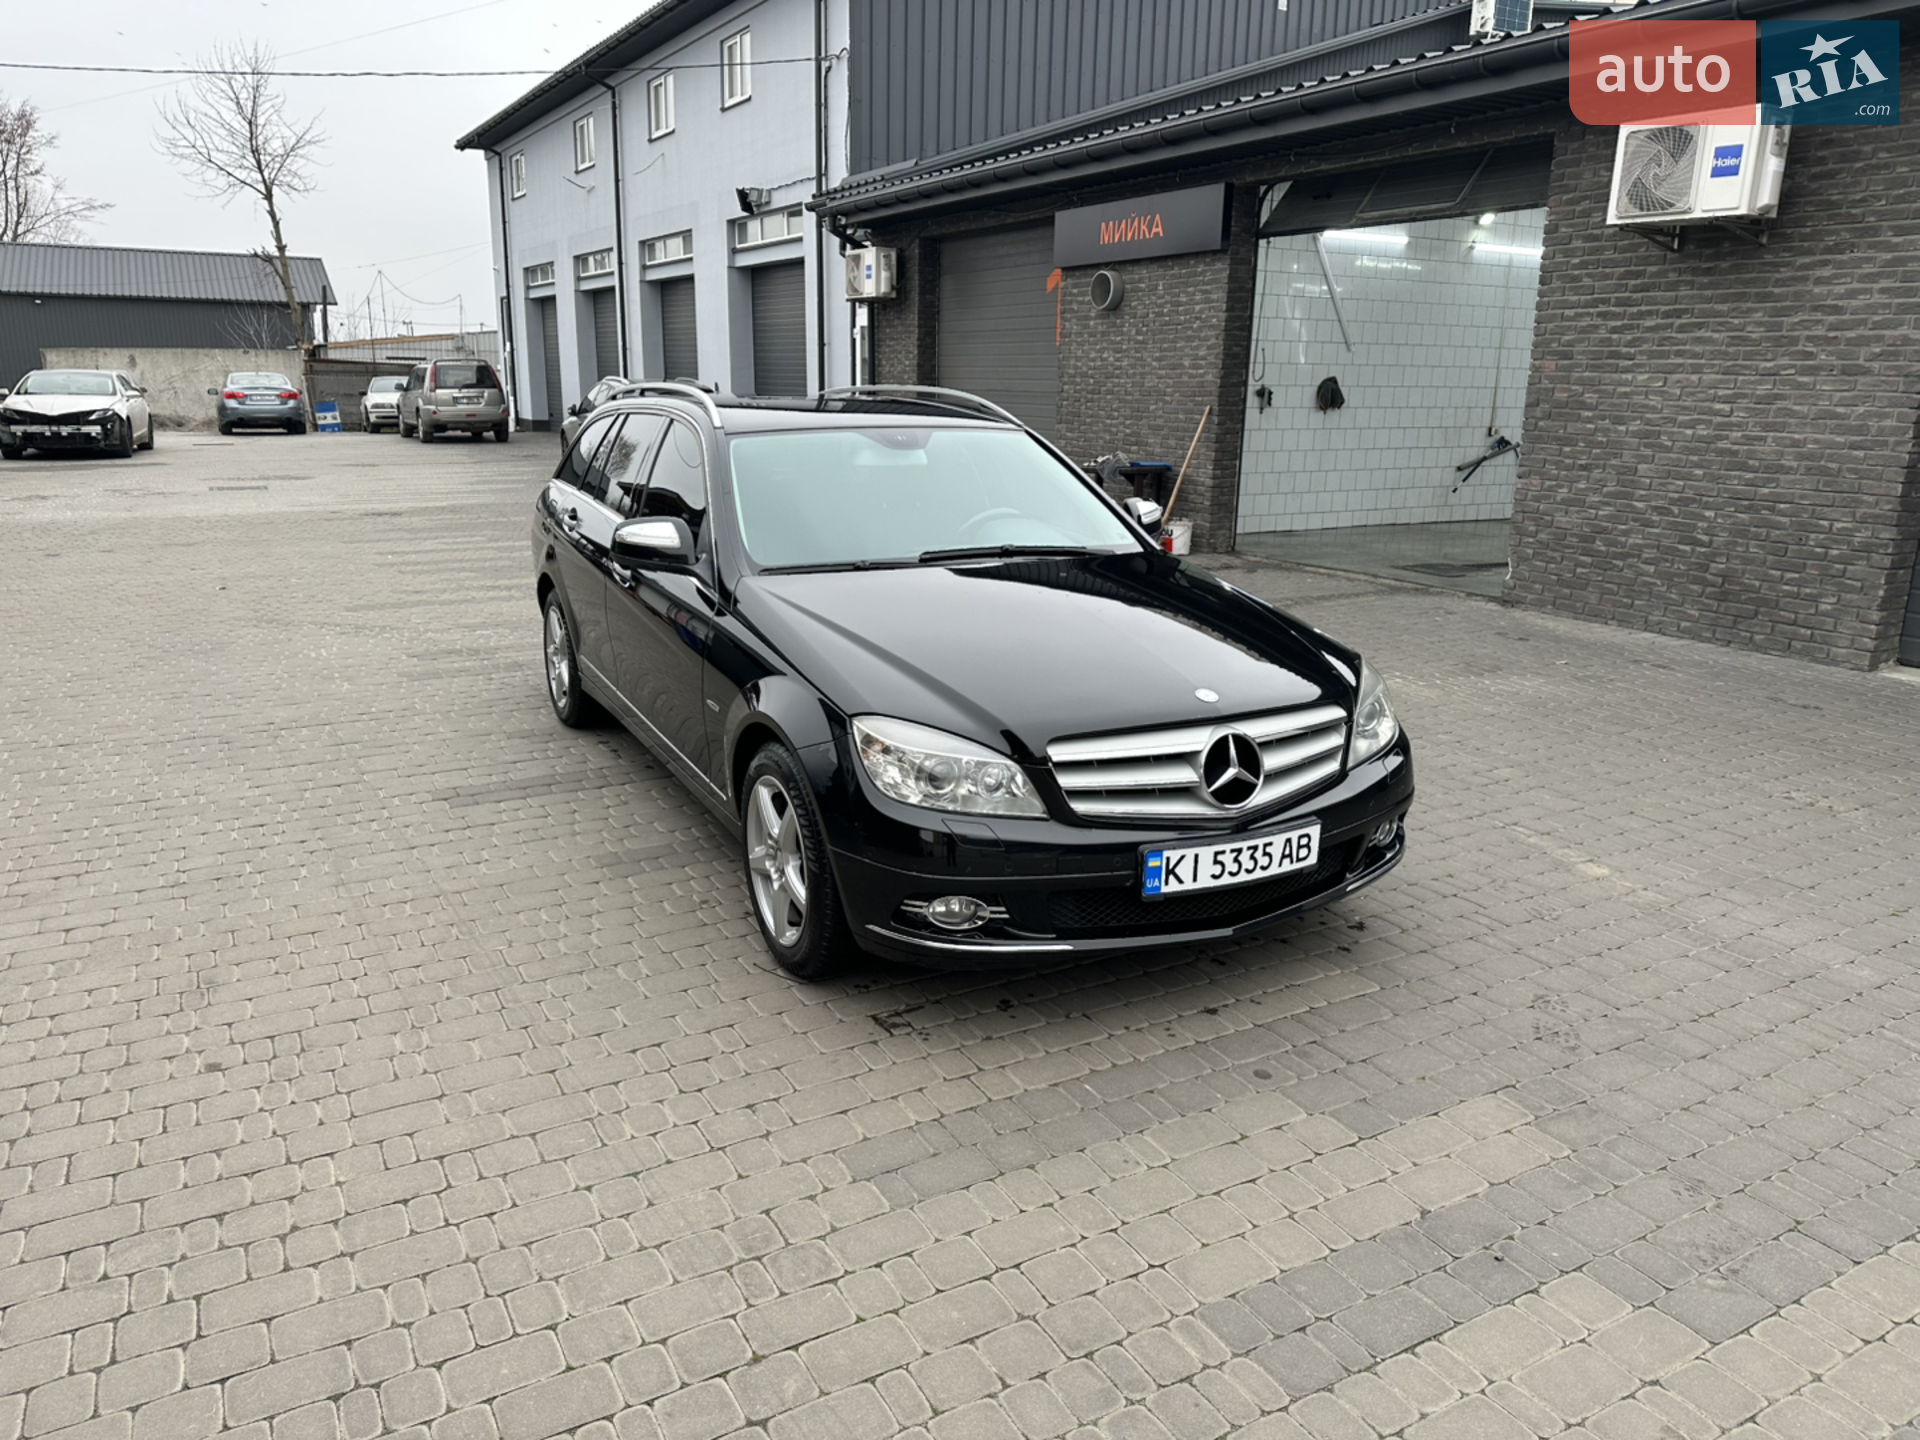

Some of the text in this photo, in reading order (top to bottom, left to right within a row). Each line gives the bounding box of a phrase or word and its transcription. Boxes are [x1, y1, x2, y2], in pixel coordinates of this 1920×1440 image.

[1712, 155, 1742, 168] Haier
[1099, 211, 1164, 245] МИЙКА
[1210, 841, 1275, 880] 5335
[1278, 832, 1312, 868] AB
[1146, 878, 1160, 888] UA
